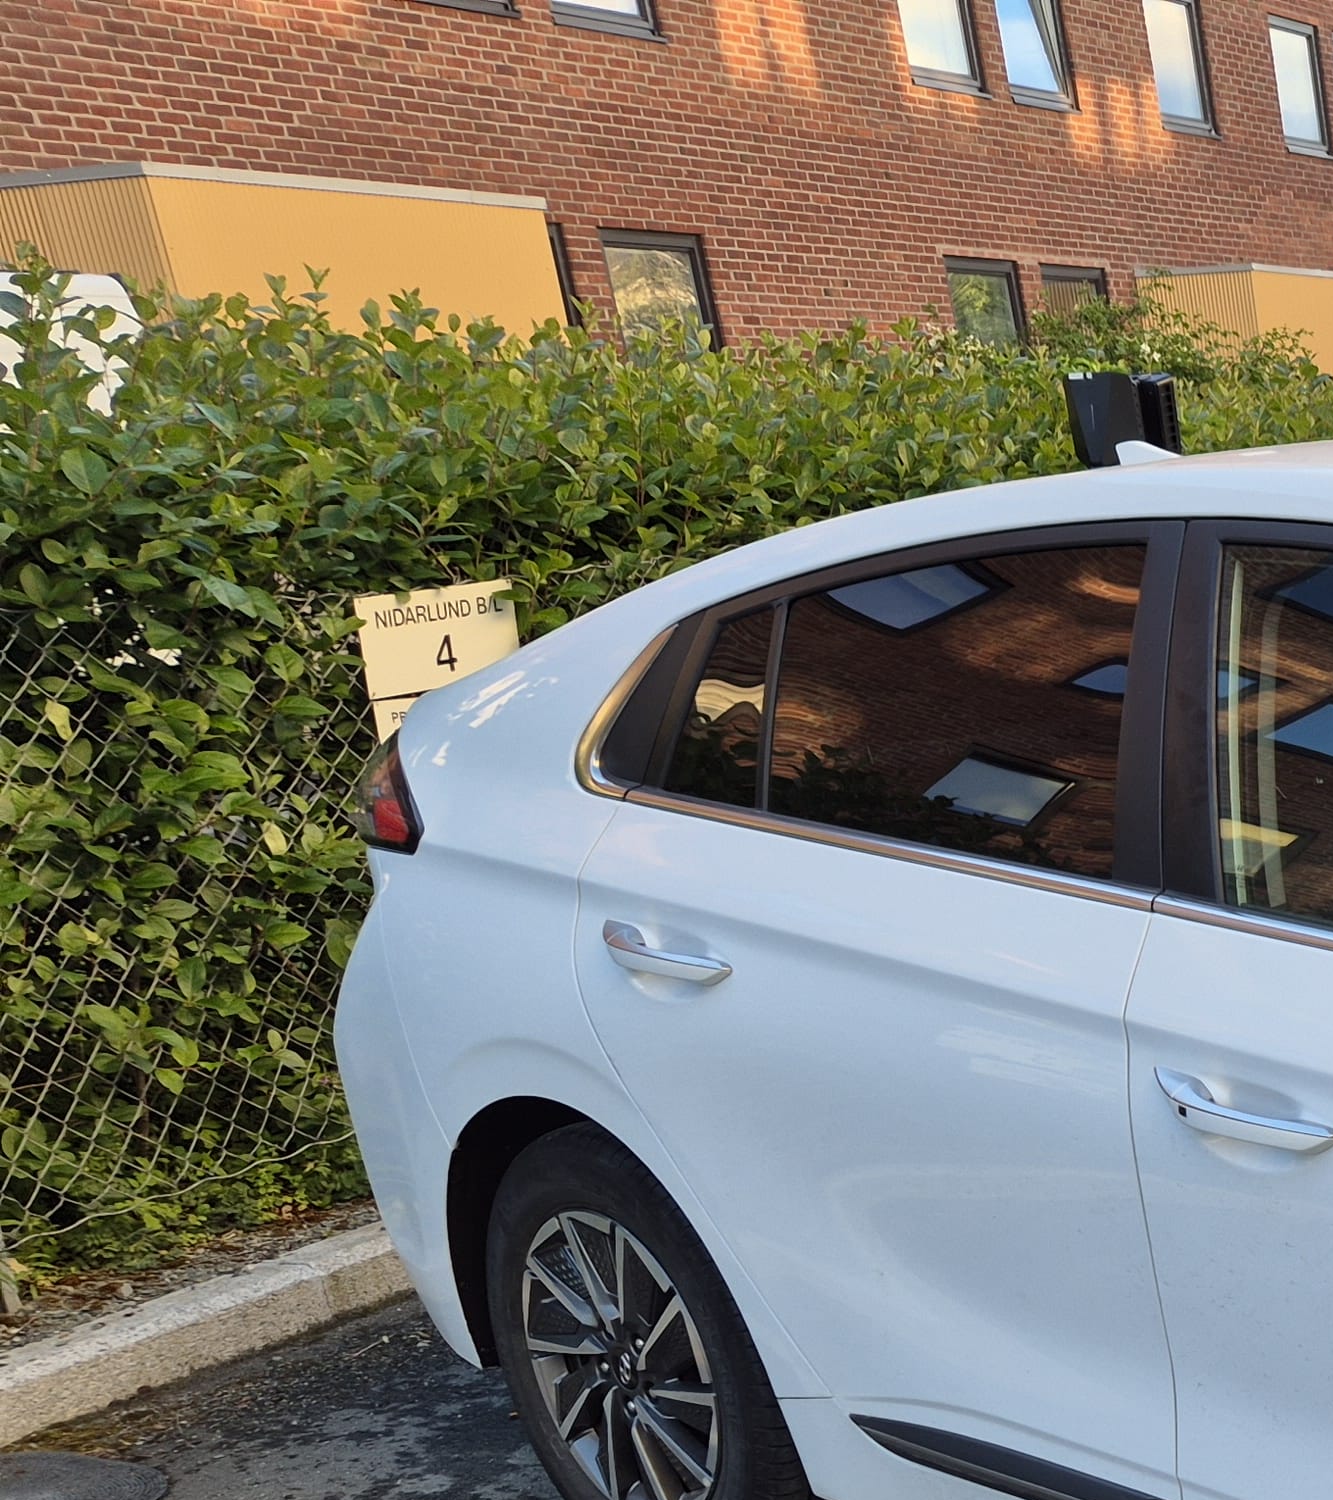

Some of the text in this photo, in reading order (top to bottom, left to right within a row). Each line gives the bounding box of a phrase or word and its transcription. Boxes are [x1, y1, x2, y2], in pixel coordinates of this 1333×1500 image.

[374, 595, 504, 629] NIDARLUND B/L
[436, 634, 458, 672] 4
